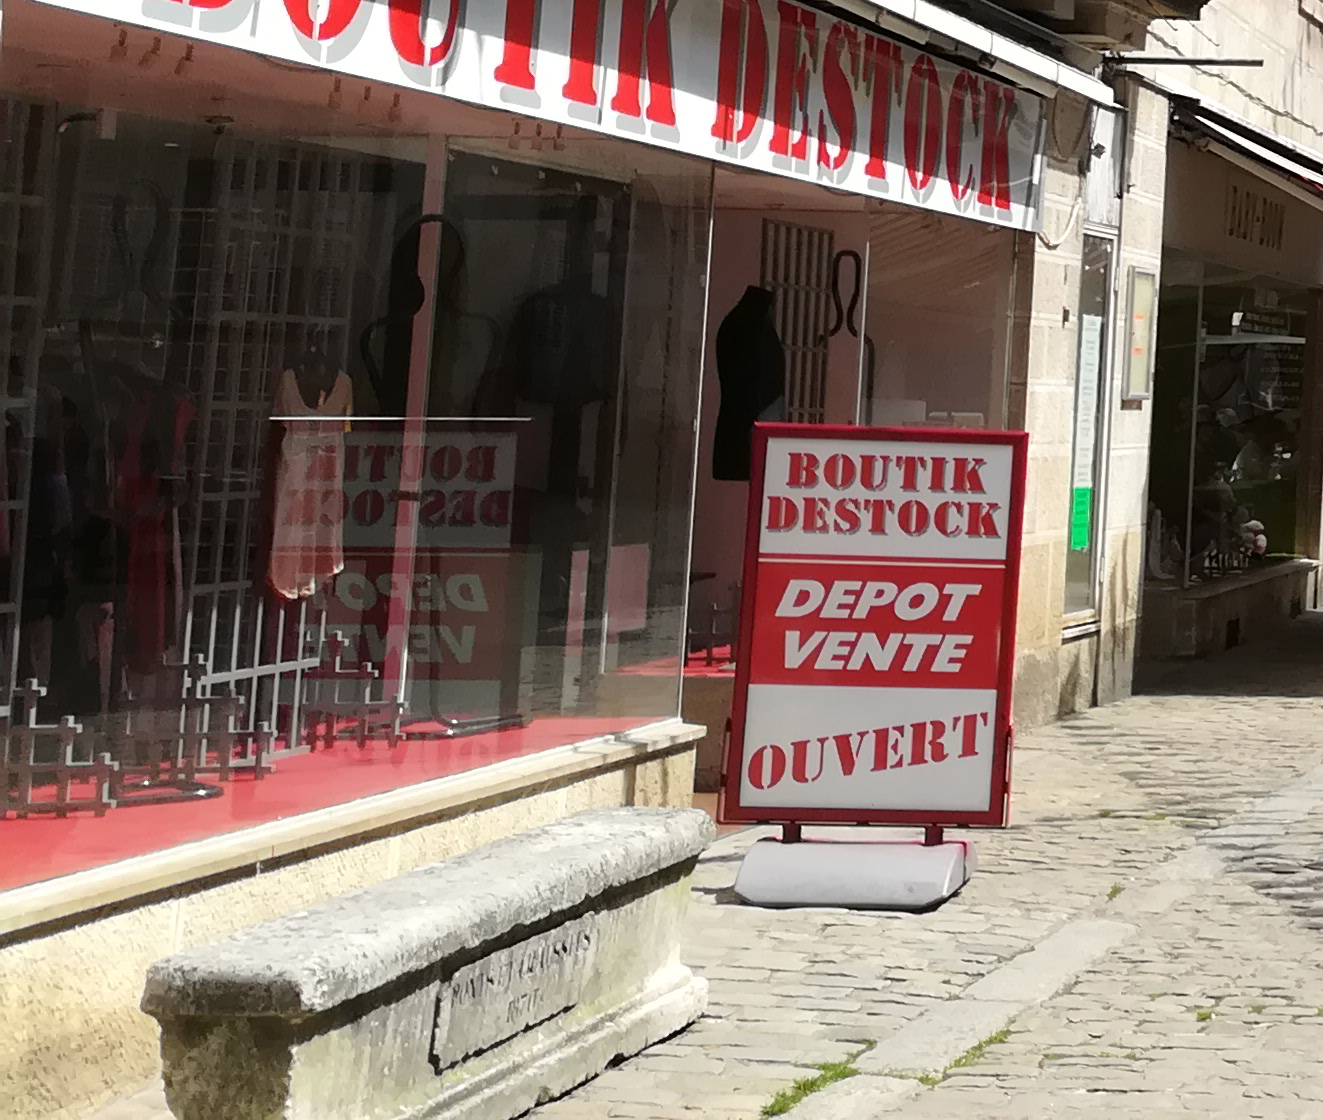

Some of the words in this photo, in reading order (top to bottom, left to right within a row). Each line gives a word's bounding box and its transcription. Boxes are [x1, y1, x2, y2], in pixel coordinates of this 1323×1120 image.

[785, 452, 988, 494] BOUTIK
[765, 496, 1002, 539] DESTOCK
[775, 579, 982, 622] DEPOT
[784, 630, 974, 673] VENTE
[747, 711, 989, 790] OUVERT
